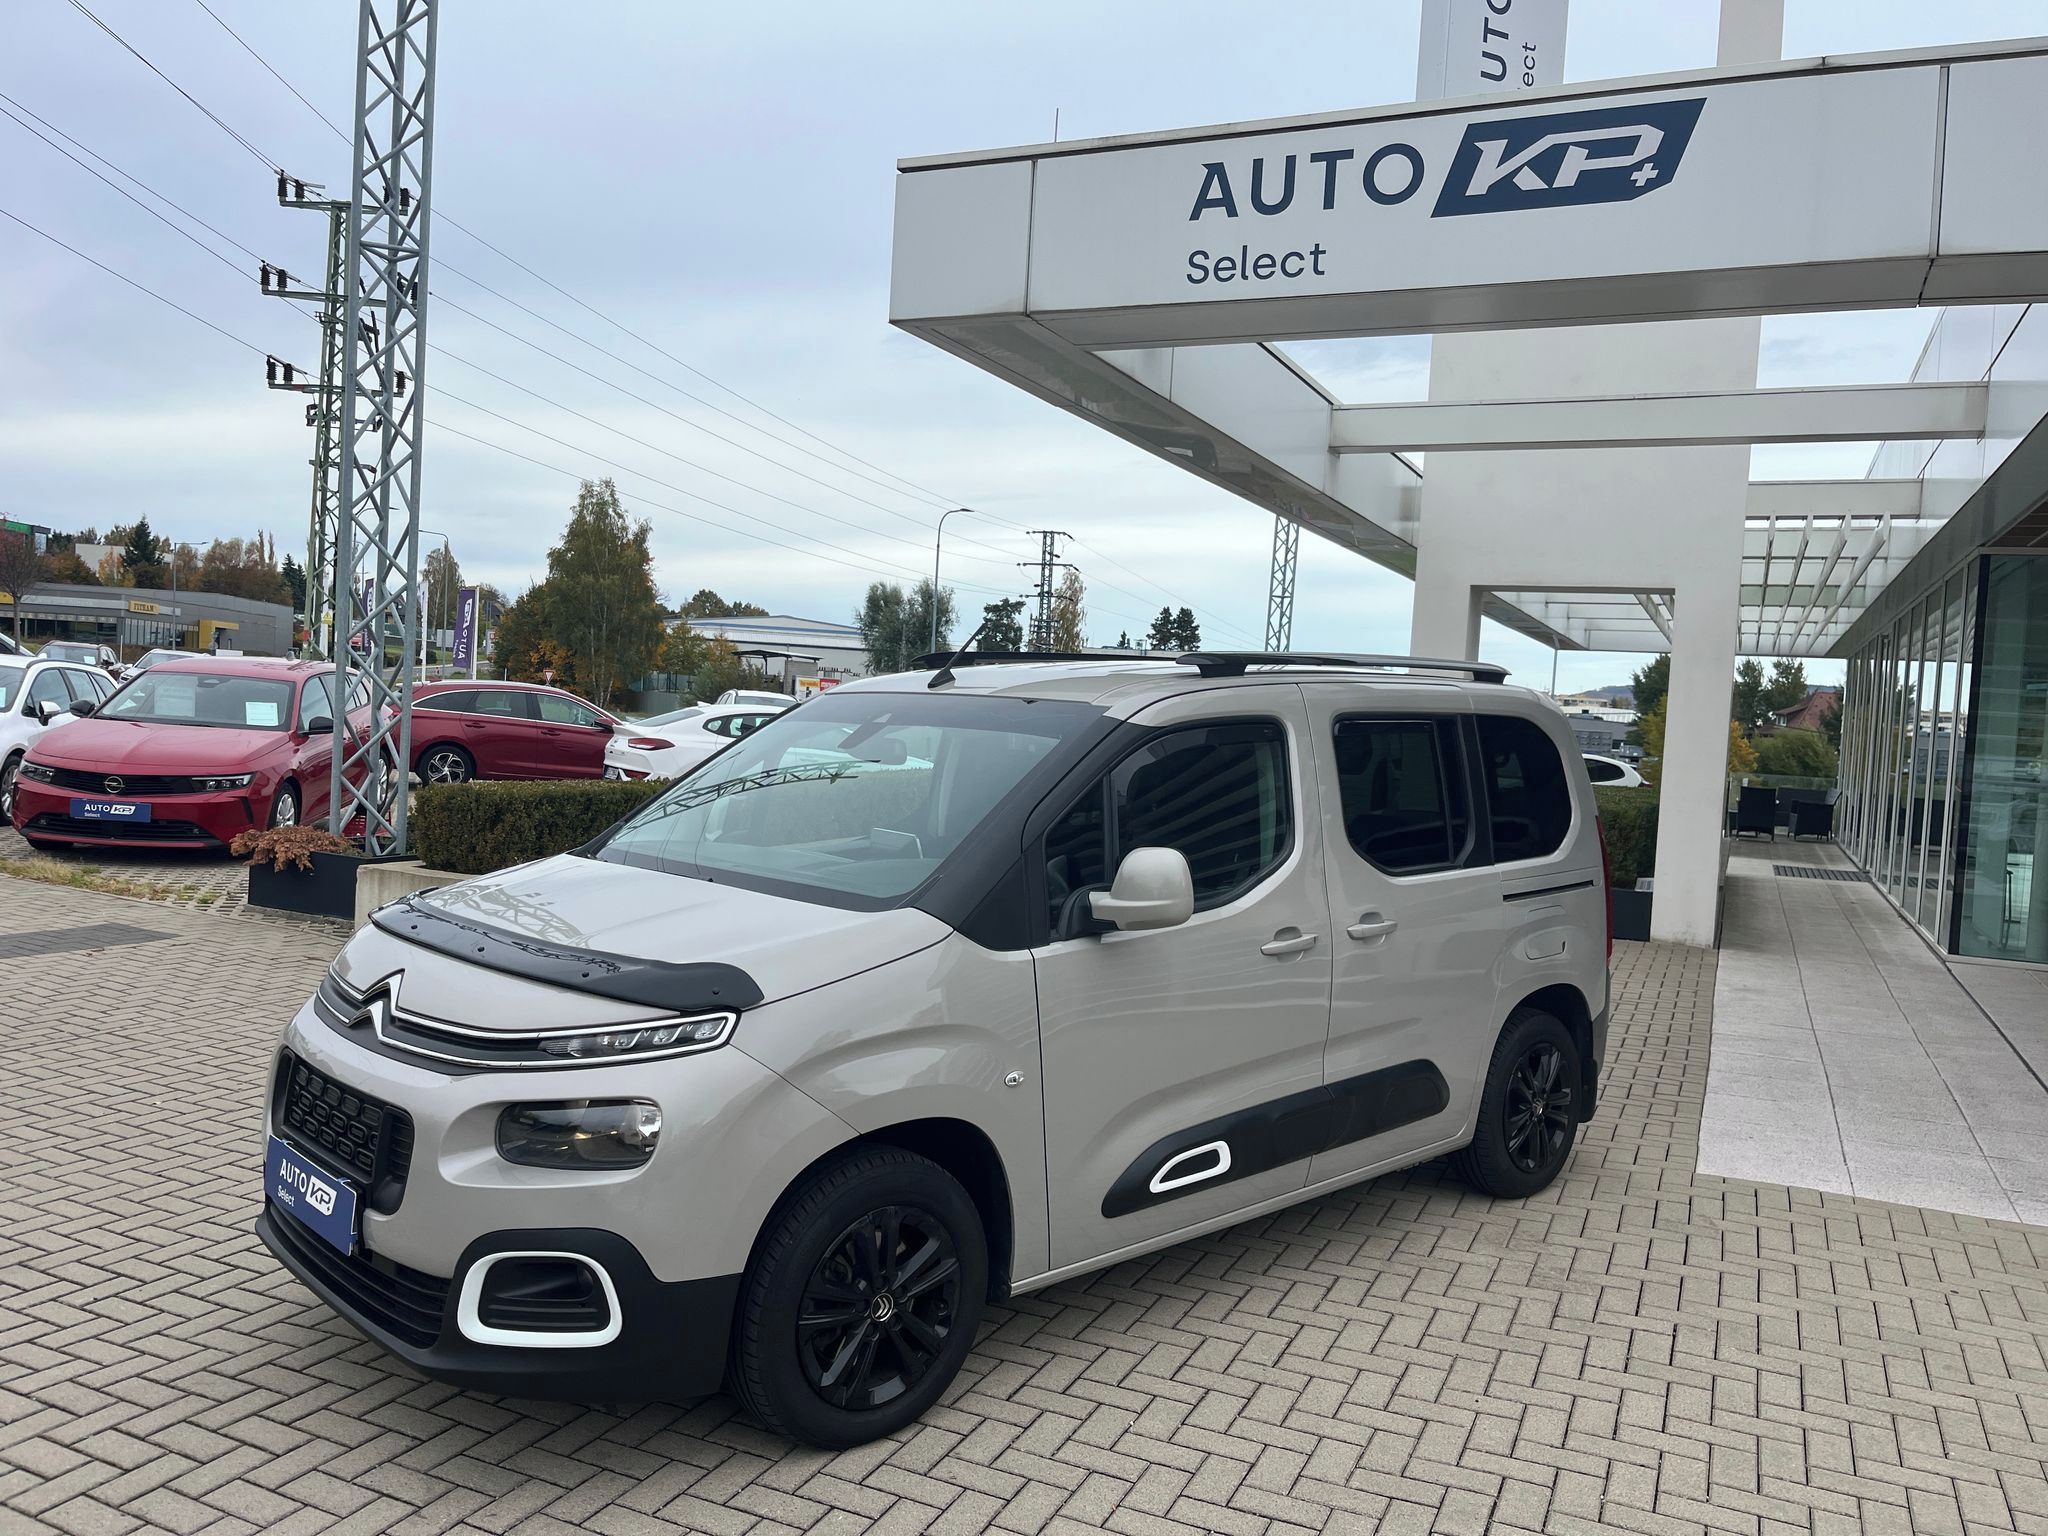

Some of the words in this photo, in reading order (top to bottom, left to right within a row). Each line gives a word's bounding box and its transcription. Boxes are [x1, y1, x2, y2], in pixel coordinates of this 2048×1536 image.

[1189, 142, 1425, 221] AUTO
[1186, 243, 1327, 285] Select
[84, 803, 111, 812] AUTO
[279, 1158, 307, 1193] AUTO
[277, 1185, 295, 1207] Select
